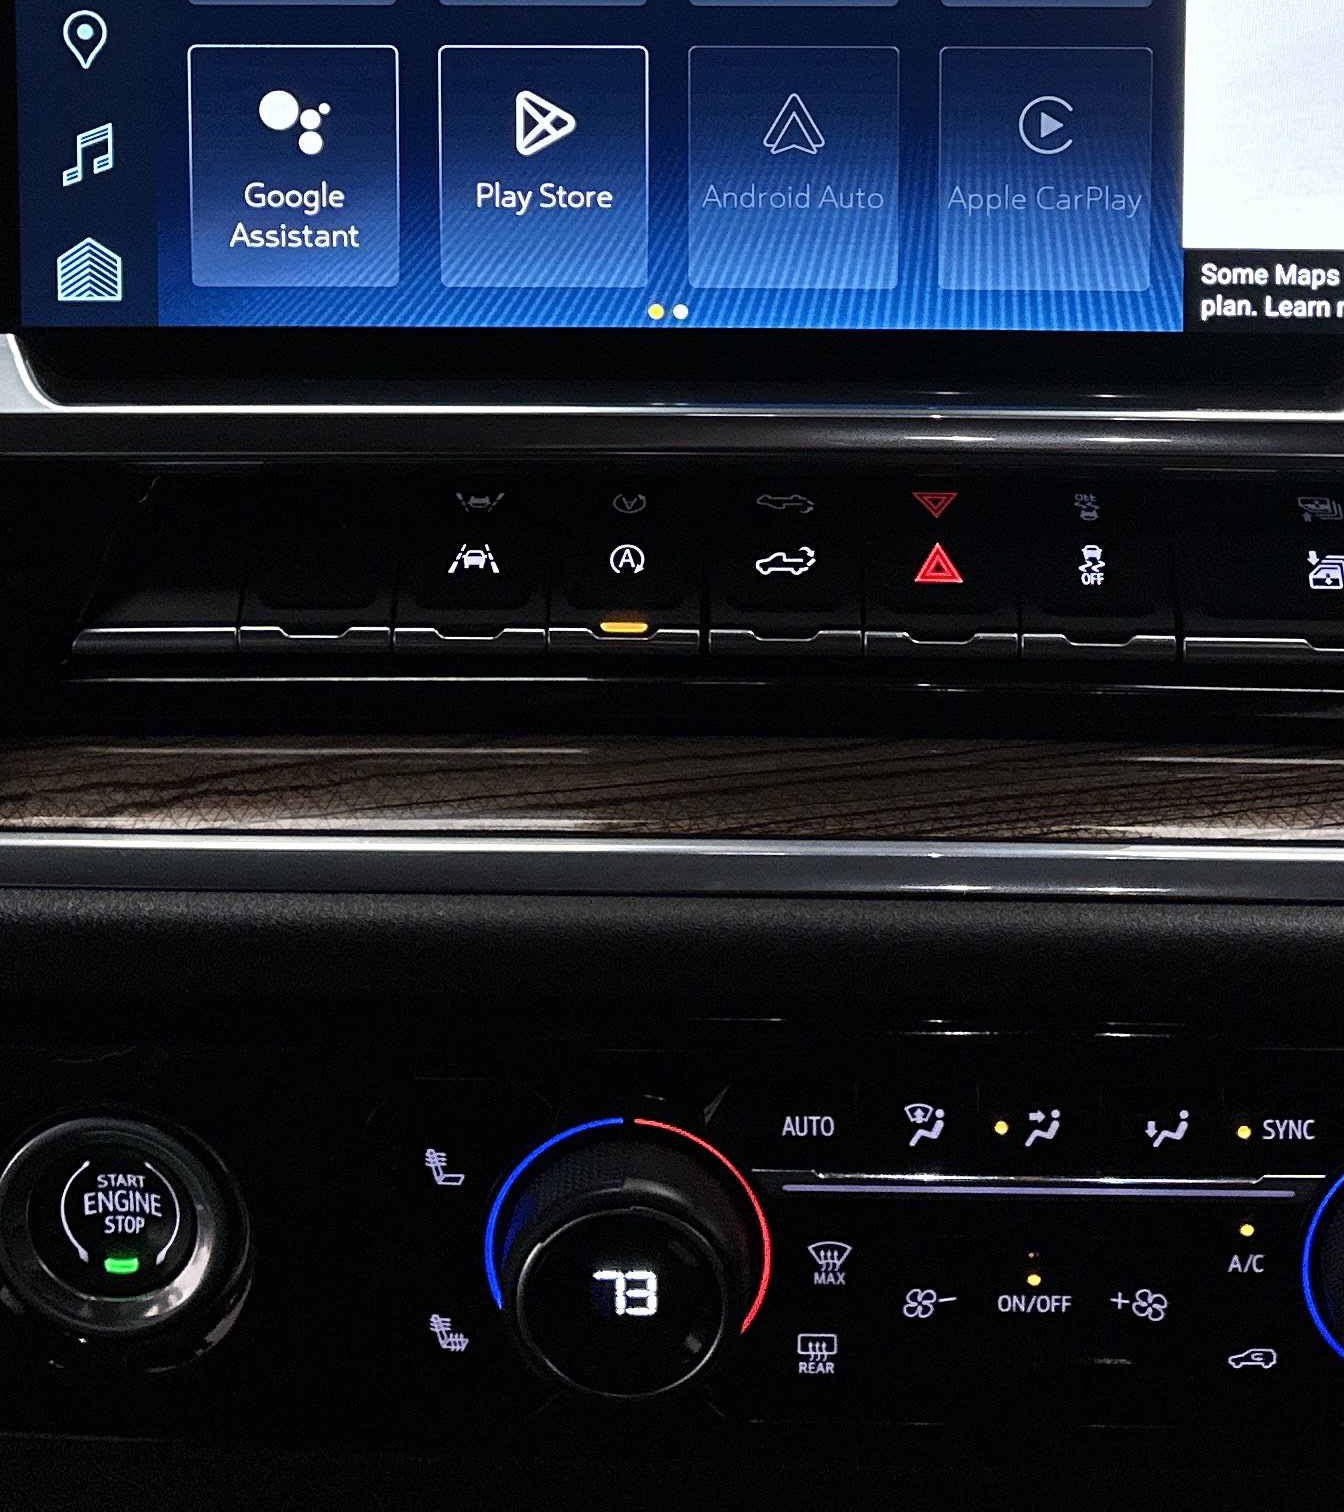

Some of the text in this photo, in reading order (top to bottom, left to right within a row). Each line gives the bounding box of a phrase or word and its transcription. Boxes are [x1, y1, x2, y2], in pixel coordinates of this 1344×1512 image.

[244, 180, 345, 216] Google
[476, 181, 613, 216] Play Store
[701, 183, 885, 209] Android Auto
[946, 183, 1143, 219] Apple CarPlay
[229, 221, 360, 248] Assistant
[1200, 262, 1269, 286] Some
[1274, 263, 1341, 291] Maps
[1200, 293, 1258, 322] plan.
[1264, 294, 1331, 318] Learn
[1080, 572, 1105, 586] OFF
[781, 1115, 835, 1137] AUTO
[1262, 1119, 1316, 1140] SYNC
[96, 1173, 146, 1189] START
[83, 1190, 163, 1218] ENGINE
[104, 1215, 146, 1235] STOP
[1227, 1254, 1265, 1273] A/C
[813, 1271, 847, 1286] MAX
[592, 1268, 658, 1316] 73
[997, 1294, 1072, 1313] ON/OFF
[798, 1360, 836, 1375] REAR
